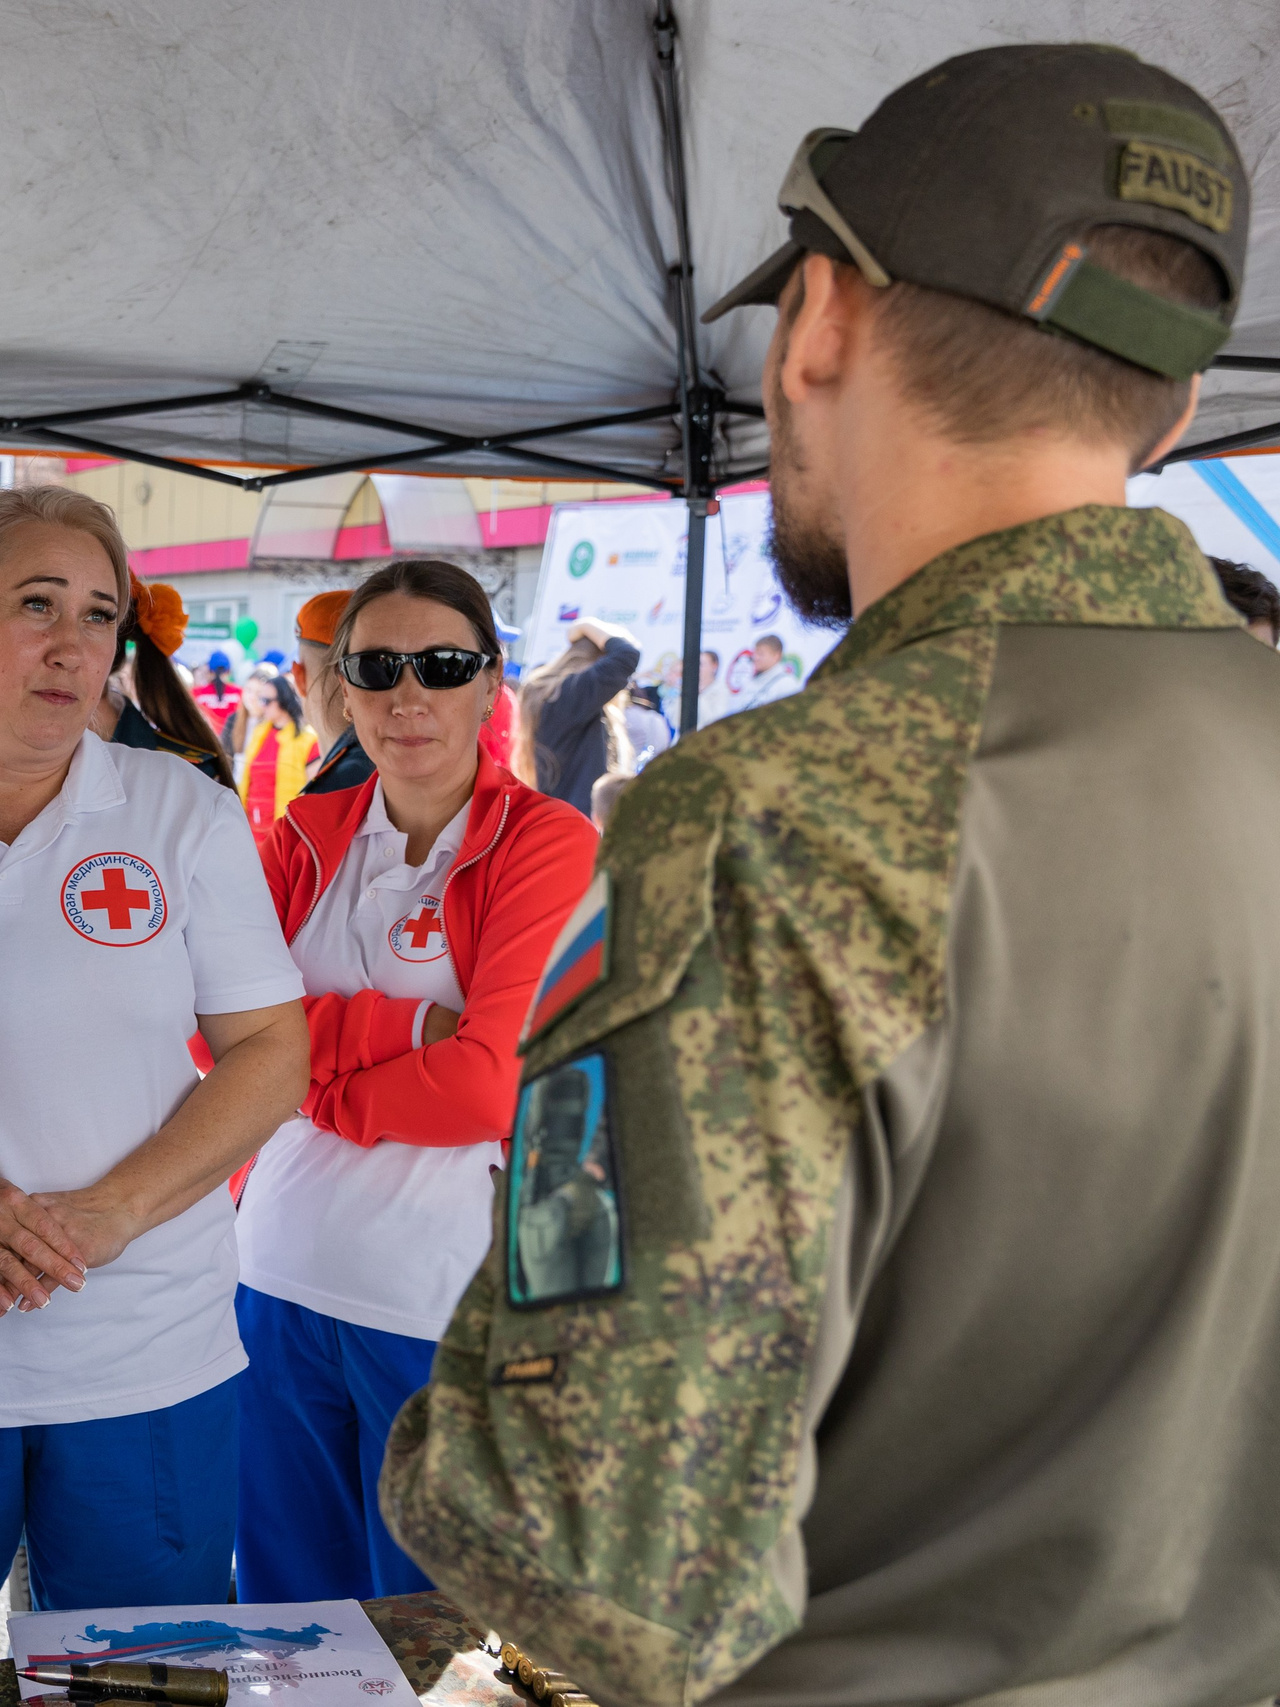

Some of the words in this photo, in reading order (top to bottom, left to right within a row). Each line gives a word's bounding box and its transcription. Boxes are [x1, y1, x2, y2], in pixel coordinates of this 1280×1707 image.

[1122, 151, 1231, 217] FAUST
[67, 855, 153, 891] медицинская
[65, 892, 95, 935] скорая
[147, 879, 164, 929] помощь
